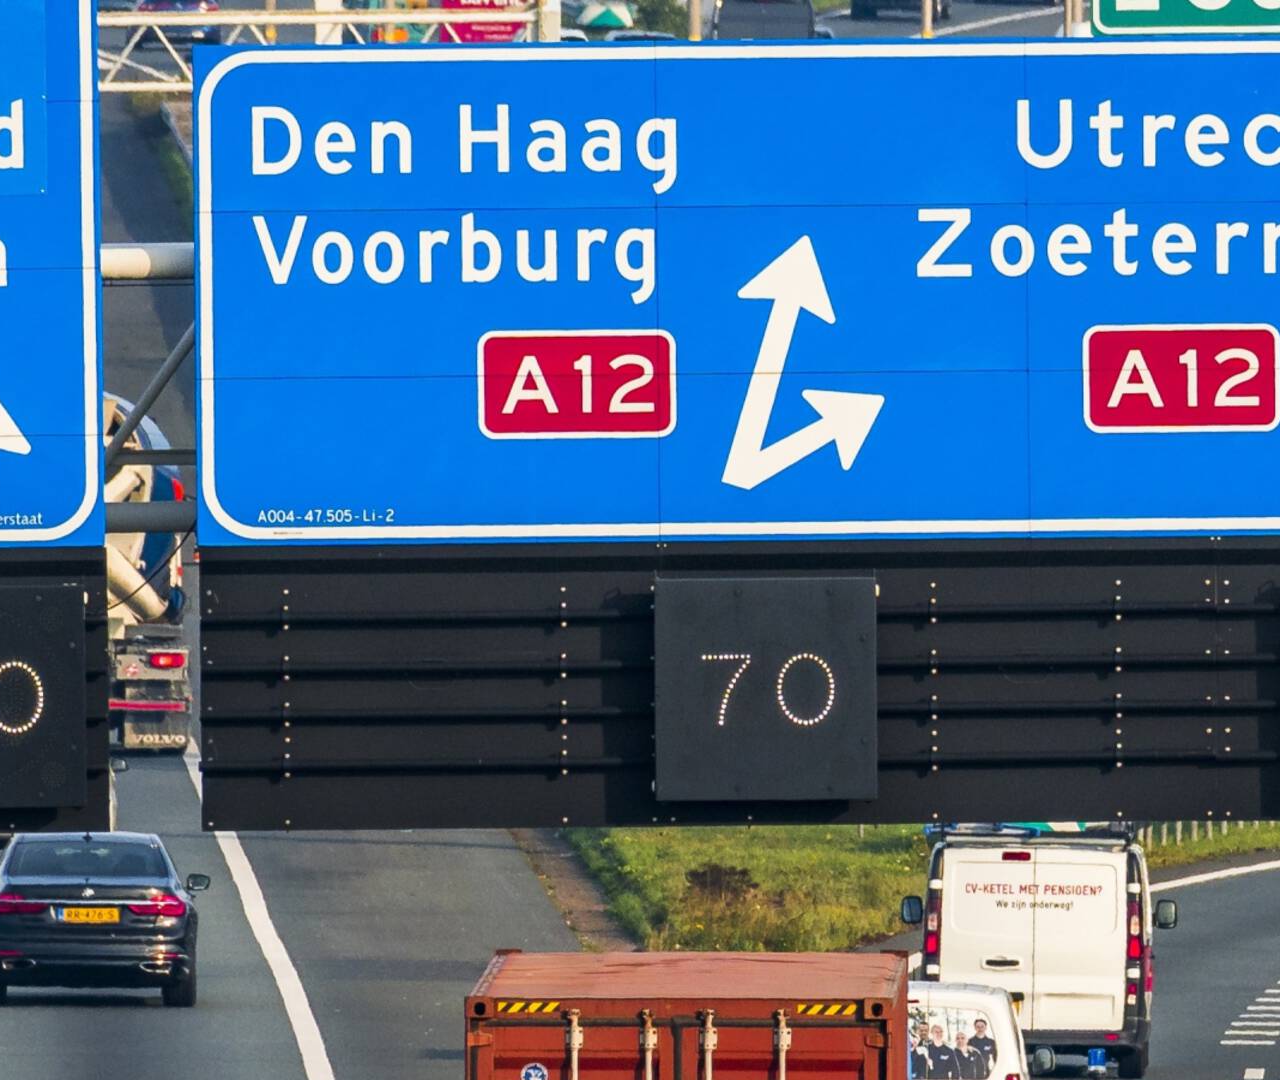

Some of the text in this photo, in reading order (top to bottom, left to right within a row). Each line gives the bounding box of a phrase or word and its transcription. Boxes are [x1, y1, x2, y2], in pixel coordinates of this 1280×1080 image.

[251, 104, 678, 194] Den Haag
[252, 213, 656, 305] Voorburg
[501, 354, 656, 415] A12
[1107, 348, 1261, 409] A12
[701, 652, 836, 725] 70
[135, 734, 186, 744] VOLVO
[965, 883, 1014, 894] CV-KETEL
[1020, 884, 1040, 895] MET
